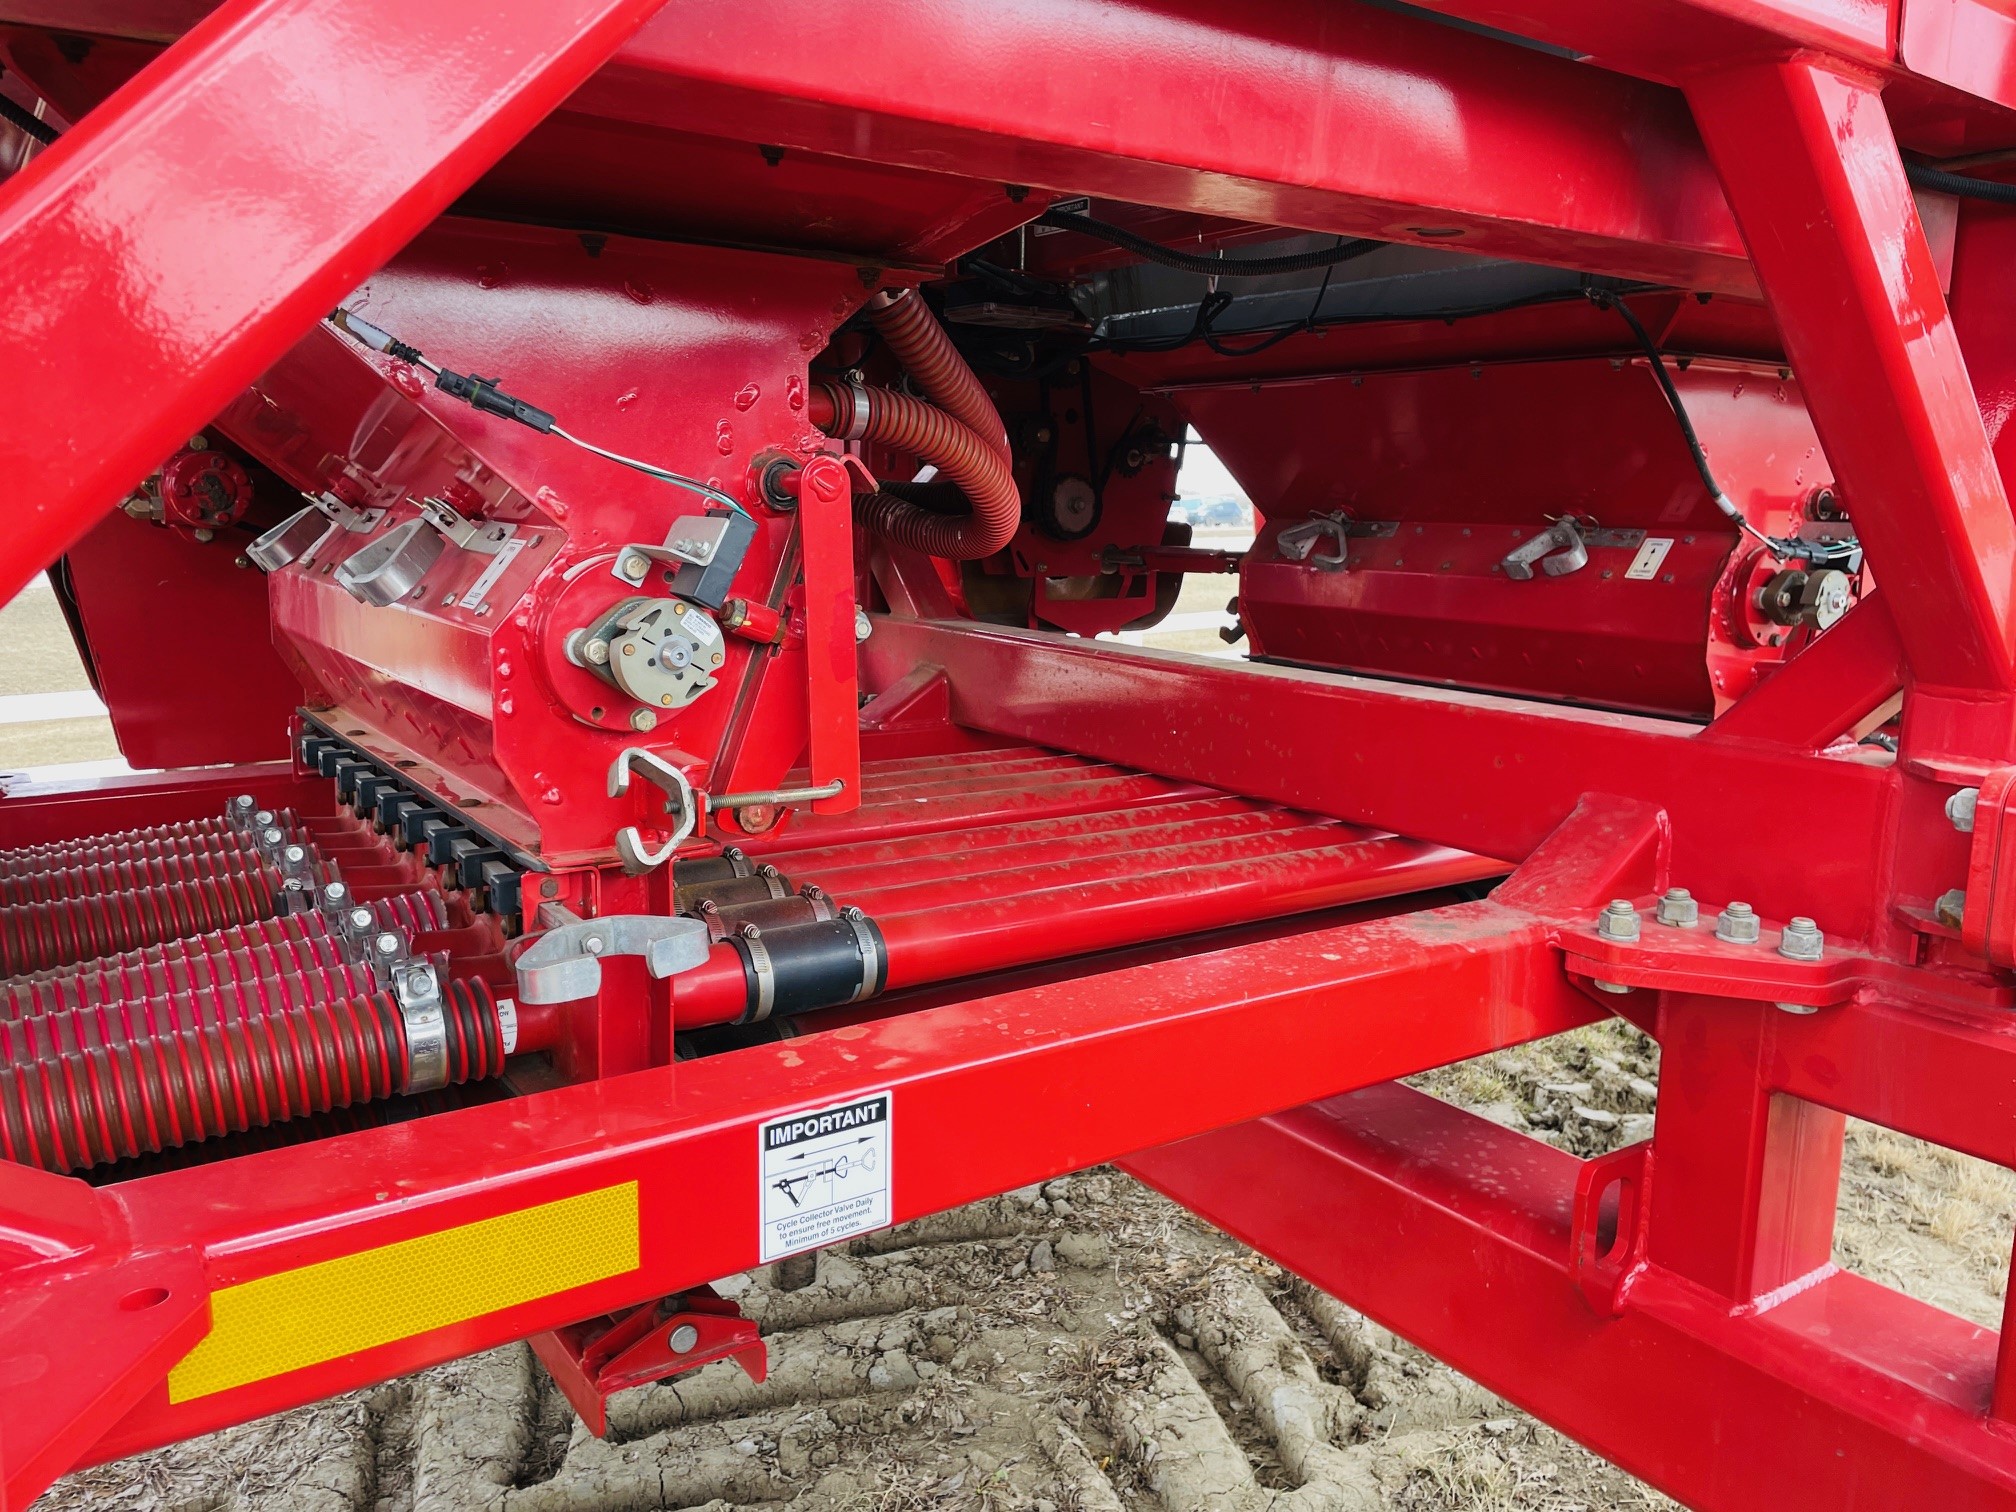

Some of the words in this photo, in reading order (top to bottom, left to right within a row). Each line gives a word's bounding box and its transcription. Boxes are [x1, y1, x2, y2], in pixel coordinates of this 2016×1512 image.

[769, 1103, 880, 1146] IMPORTANT
[776, 1220, 798, 1231] Cycle
[800, 1209, 833, 1224] Collector
[834, 1203, 854, 1213] Valve
[856, 1197, 873, 1207] Daily
[789, 1224, 814, 1236] ensure
[816, 1219, 831, 1229] free
[833, 1207, 872, 1224] movement.
[785, 1234, 819, 1247] Minimum
[821, 1228, 829, 1236] of
[836, 1221, 862, 1232] cycles.
